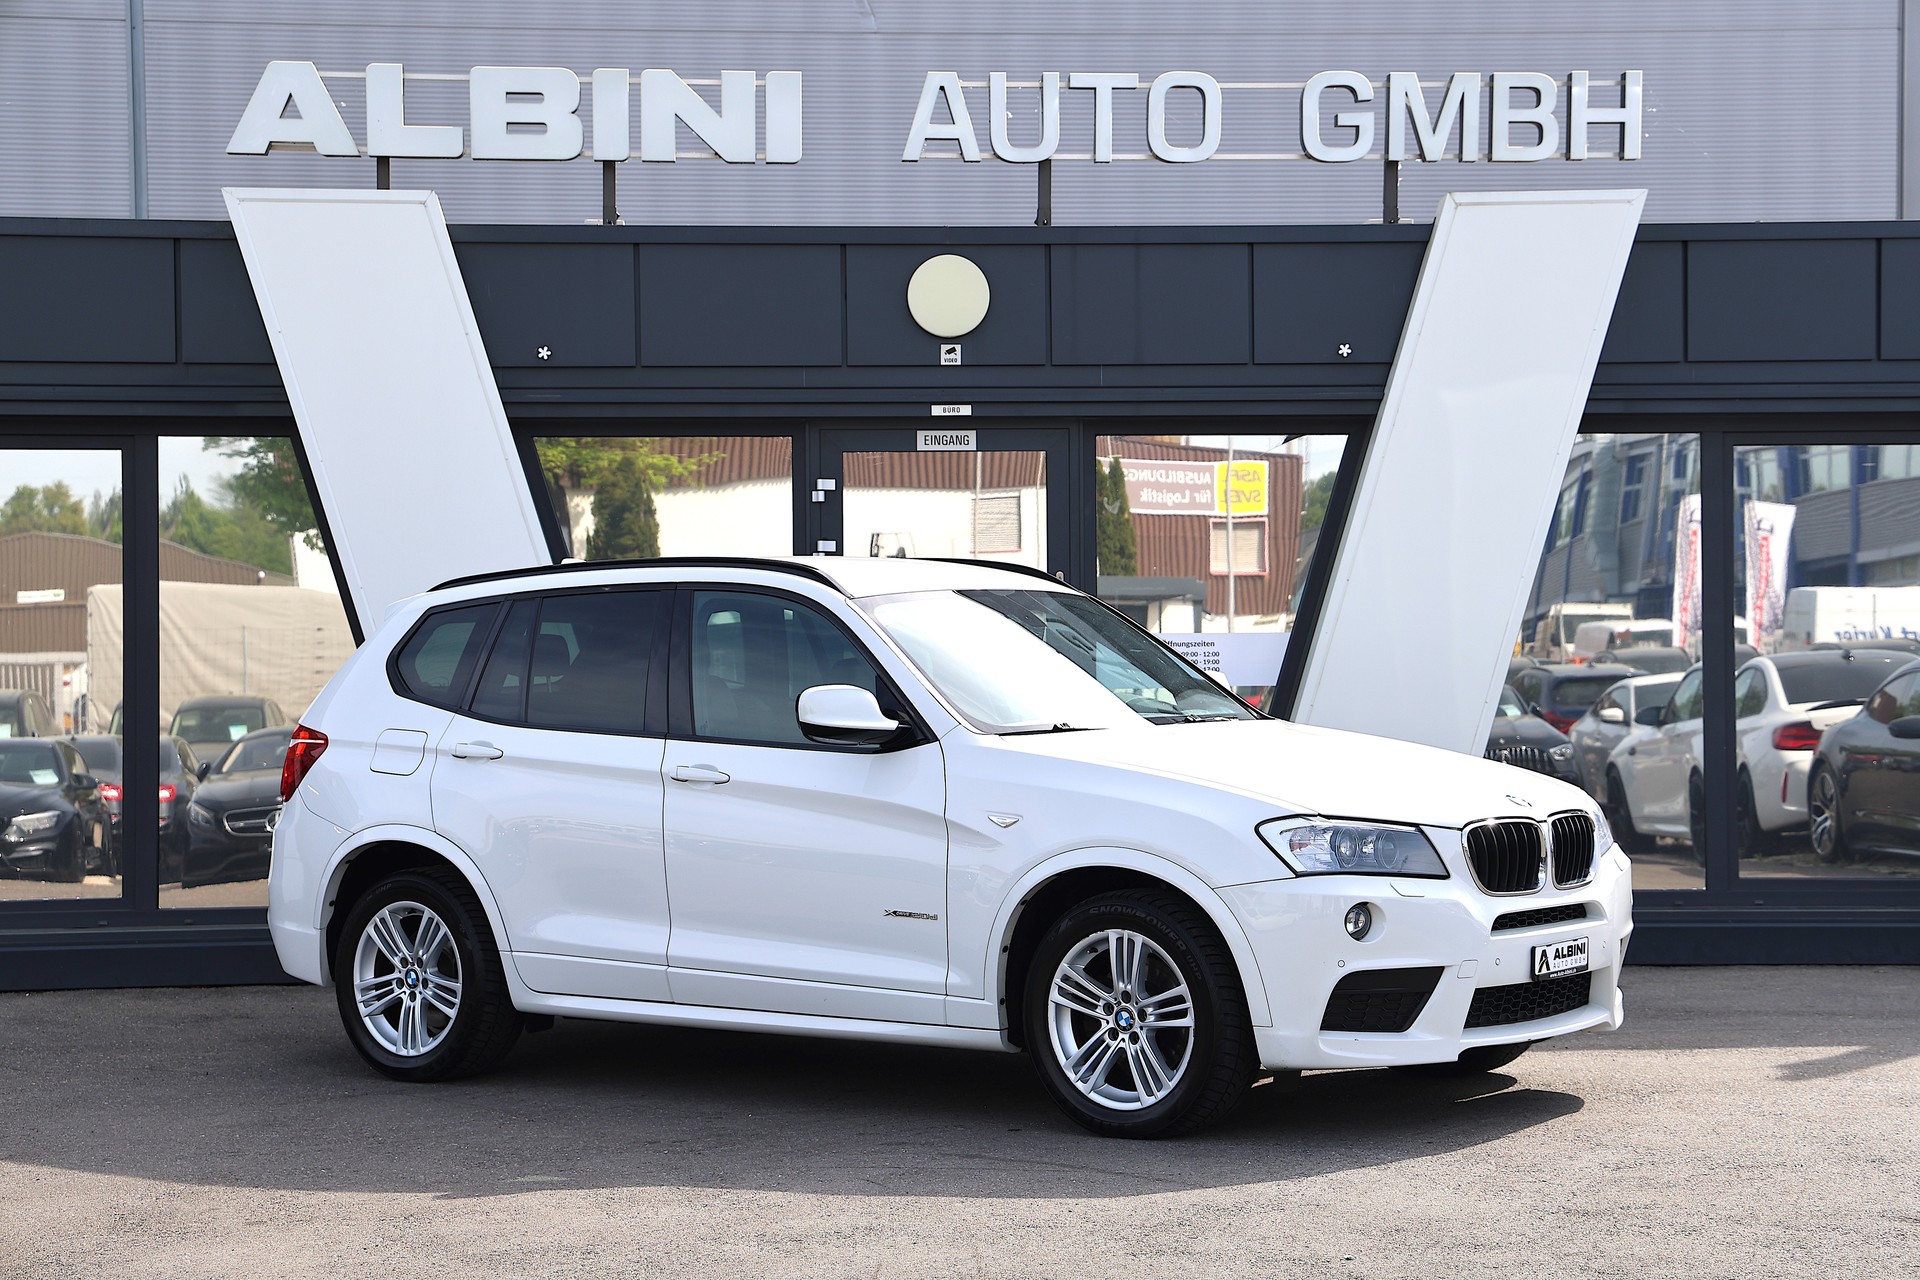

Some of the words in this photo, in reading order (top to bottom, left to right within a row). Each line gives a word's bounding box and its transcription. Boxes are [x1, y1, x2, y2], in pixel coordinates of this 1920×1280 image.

[226, 61, 802, 164] ALBINI
[902, 70, 1222, 164] AUTO
[1302, 70, 1643, 163] GMBH
[942, 405, 961, 413] BÜRO
[924, 434, 970, 446] EINGANG
[1553, 942, 1585, 960] ALBINI
[1552, 959, 1569, 969] AUTO
